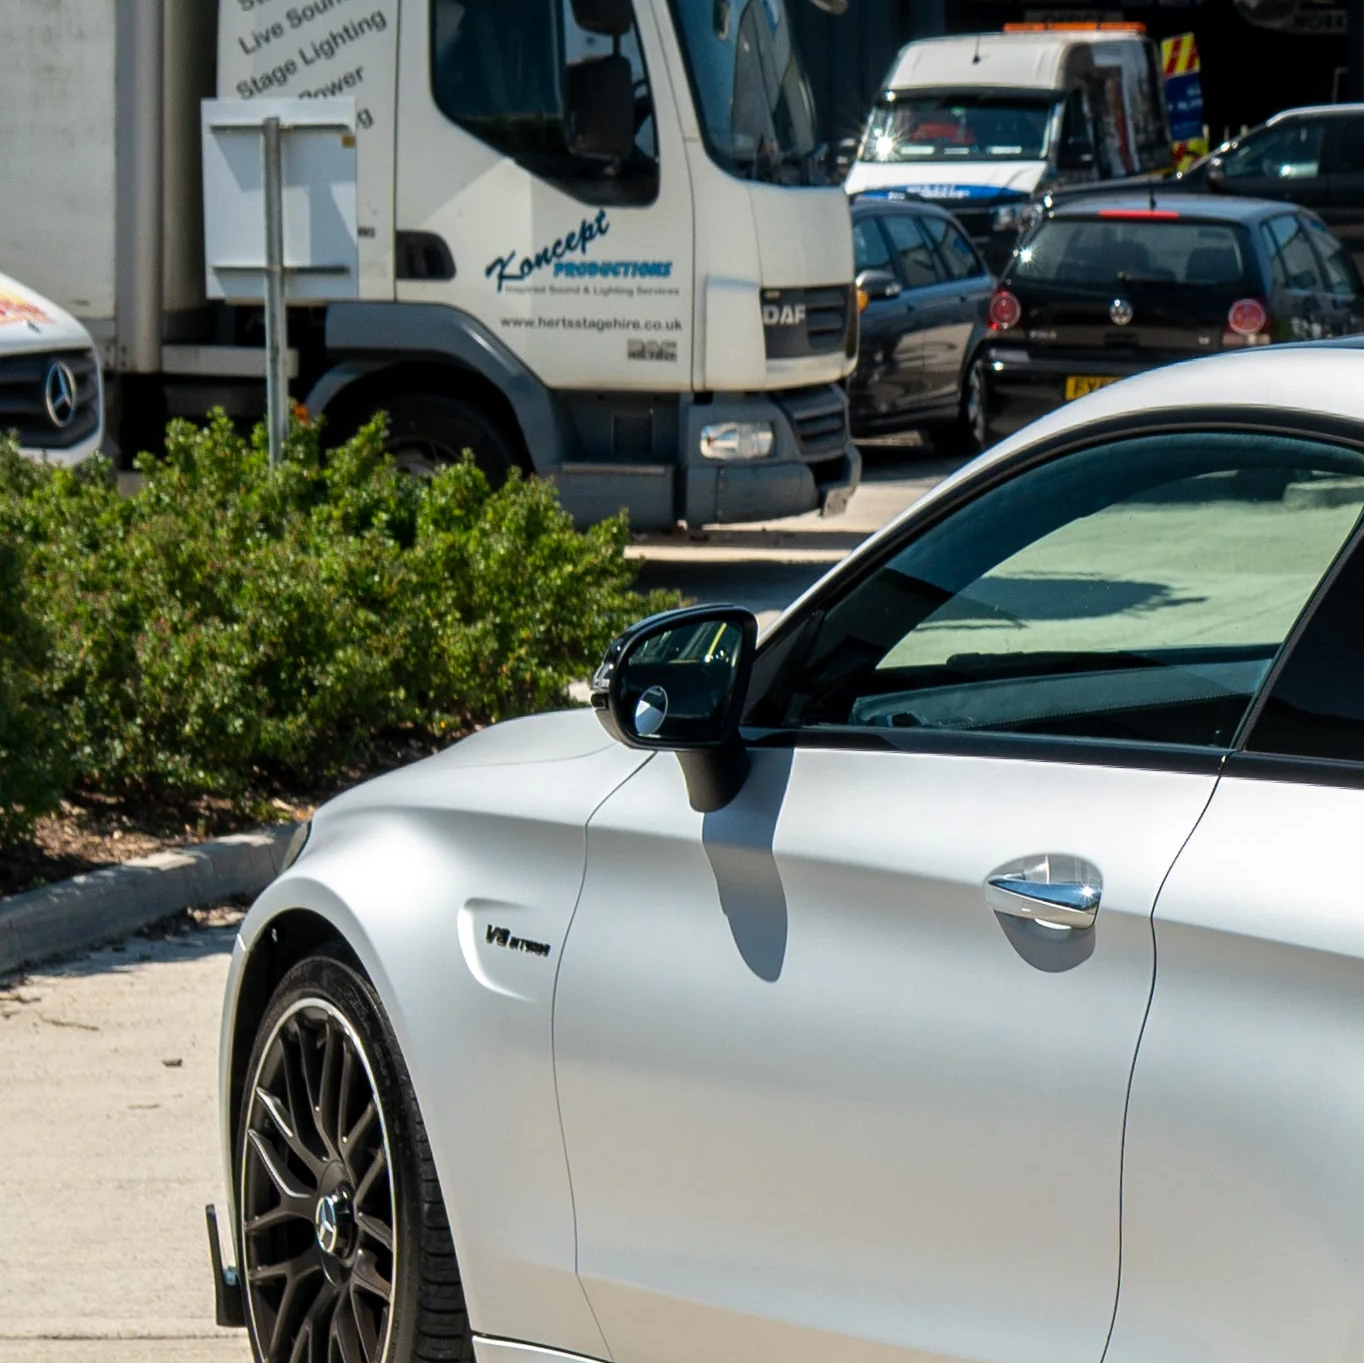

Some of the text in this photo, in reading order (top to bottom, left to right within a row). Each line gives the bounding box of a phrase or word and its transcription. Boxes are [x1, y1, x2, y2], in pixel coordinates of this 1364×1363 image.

[236, 10, 387, 100] Stage Lighting
[238, 22, 285, 55] Live
[485, 208, 610, 293] Koncept
[553, 261, 673, 278] PRODUCTIONS
[763, 304, 807, 326] DAF
